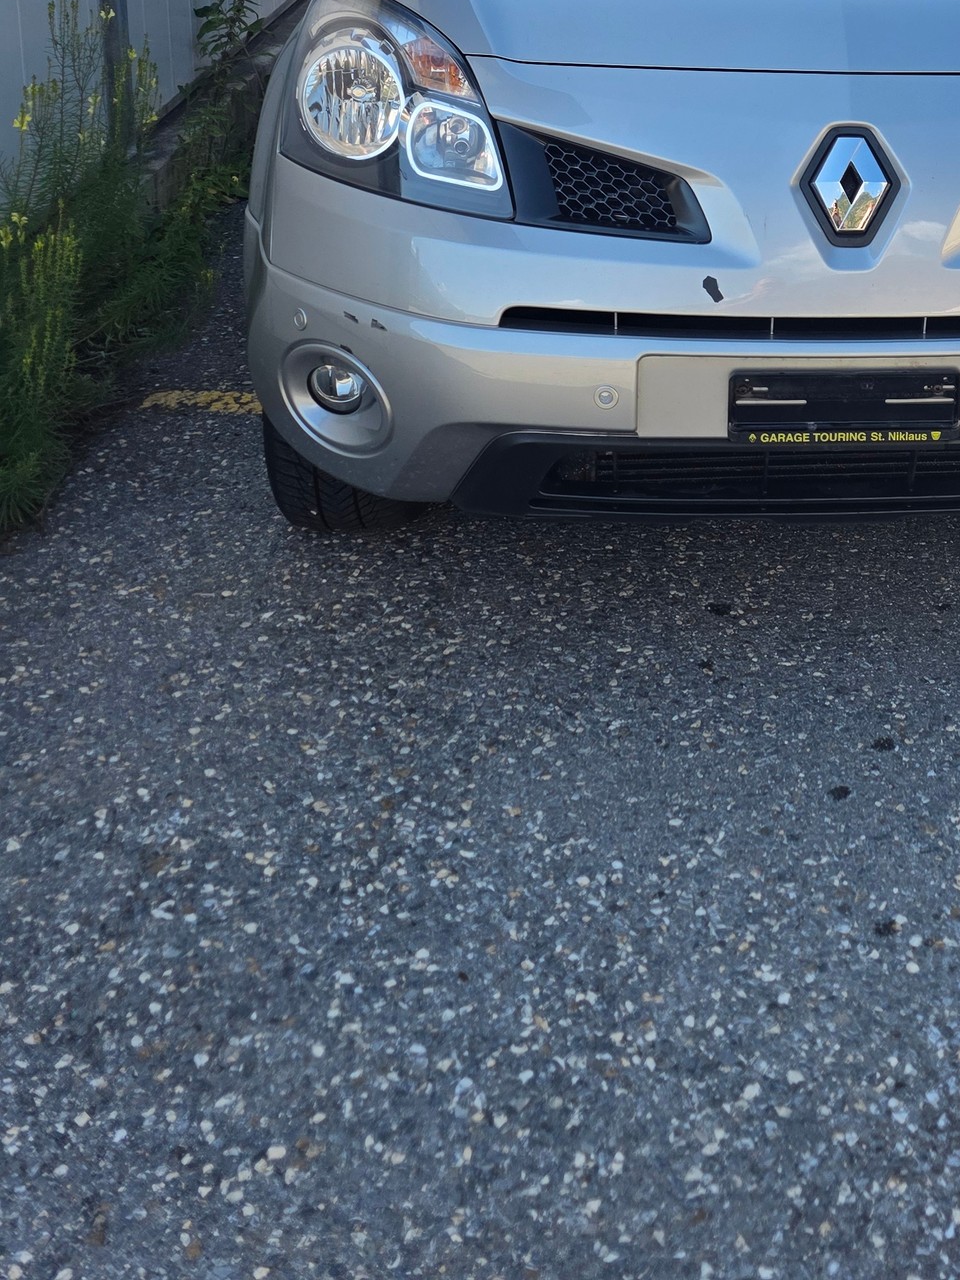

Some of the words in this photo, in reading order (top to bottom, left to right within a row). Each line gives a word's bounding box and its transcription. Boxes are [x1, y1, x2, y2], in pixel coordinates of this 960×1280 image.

[760, 433, 810, 443] GARAGE
[813, 432, 867, 442] TOURING
[870, 432, 885, 441] St.
[888, 431, 928, 441] Niklaus
